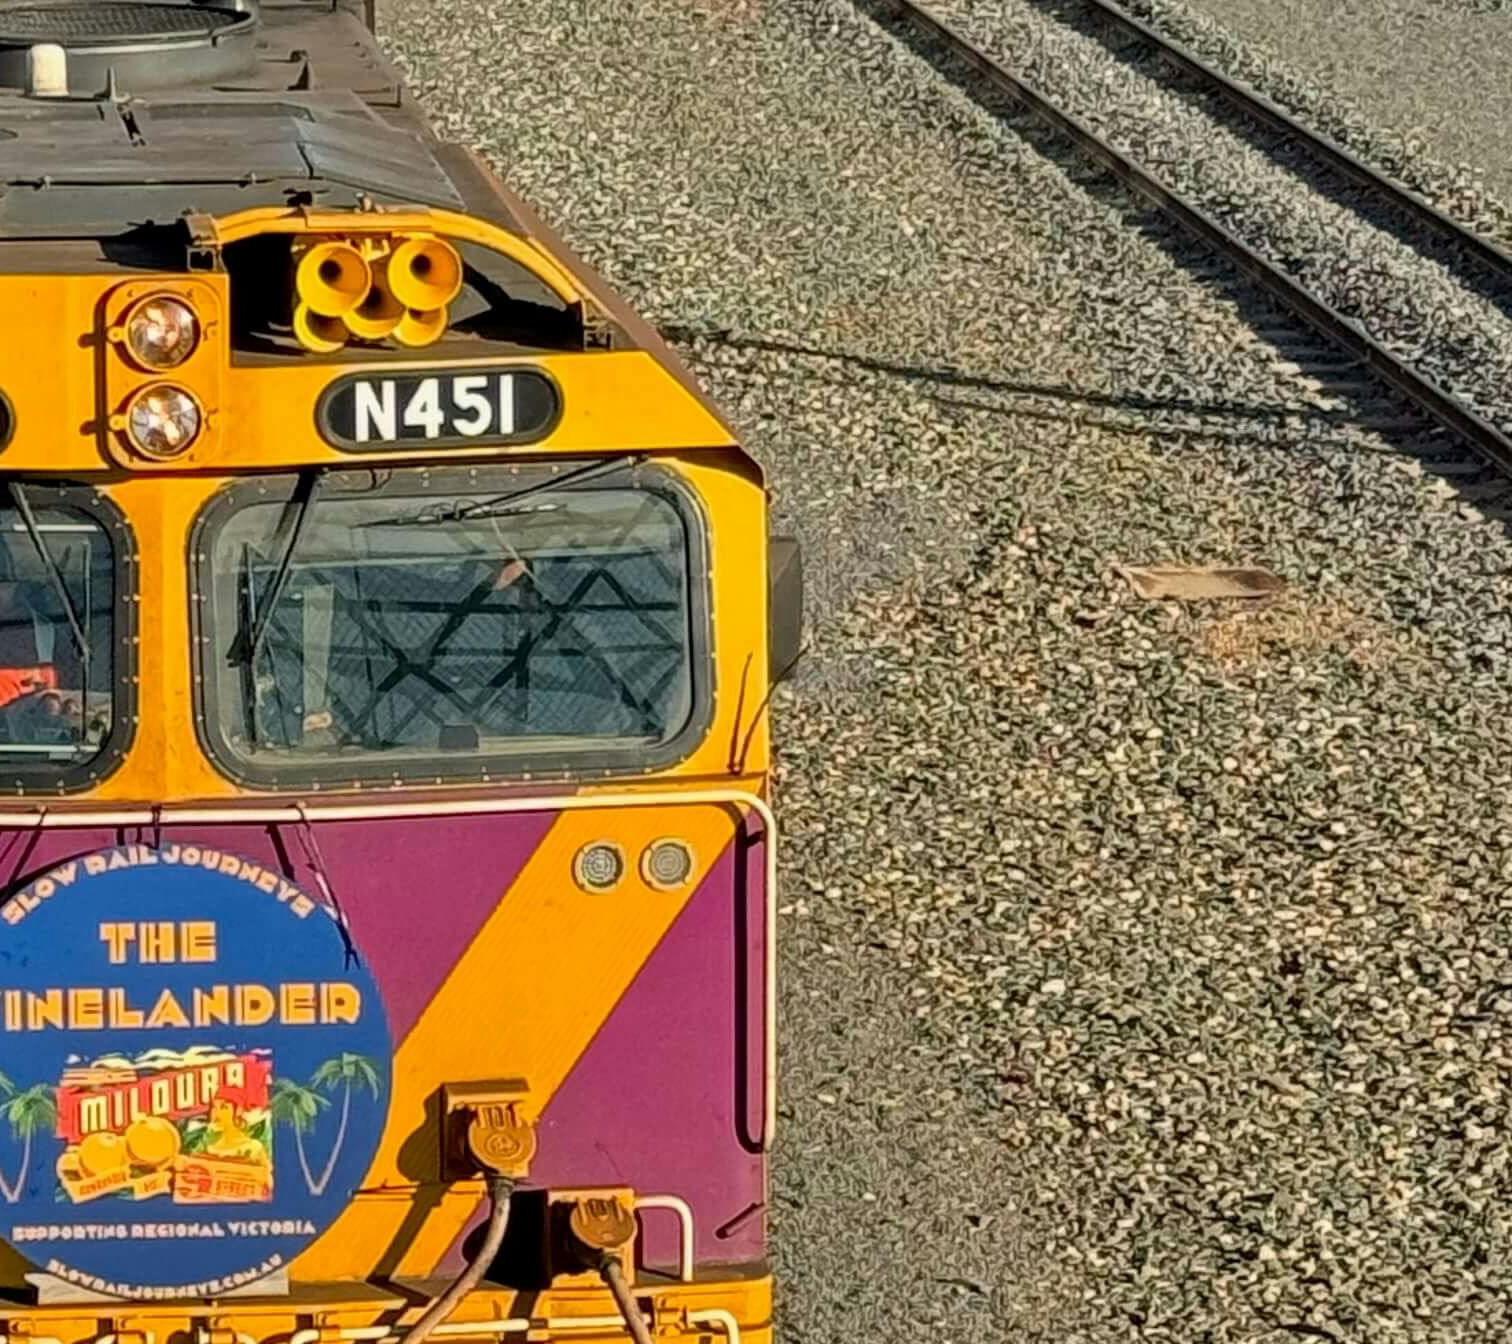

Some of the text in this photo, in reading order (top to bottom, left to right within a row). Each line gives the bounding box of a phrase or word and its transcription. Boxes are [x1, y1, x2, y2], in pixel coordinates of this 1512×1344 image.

[355, 374, 514, 442] N451
[1, 844, 315, 925] SLOW RAIL JOURNEYS
[99, 921, 217, 964] THE
[12, 1219, 317, 1241] SUPPORTING REGIONAL VICTORIA
